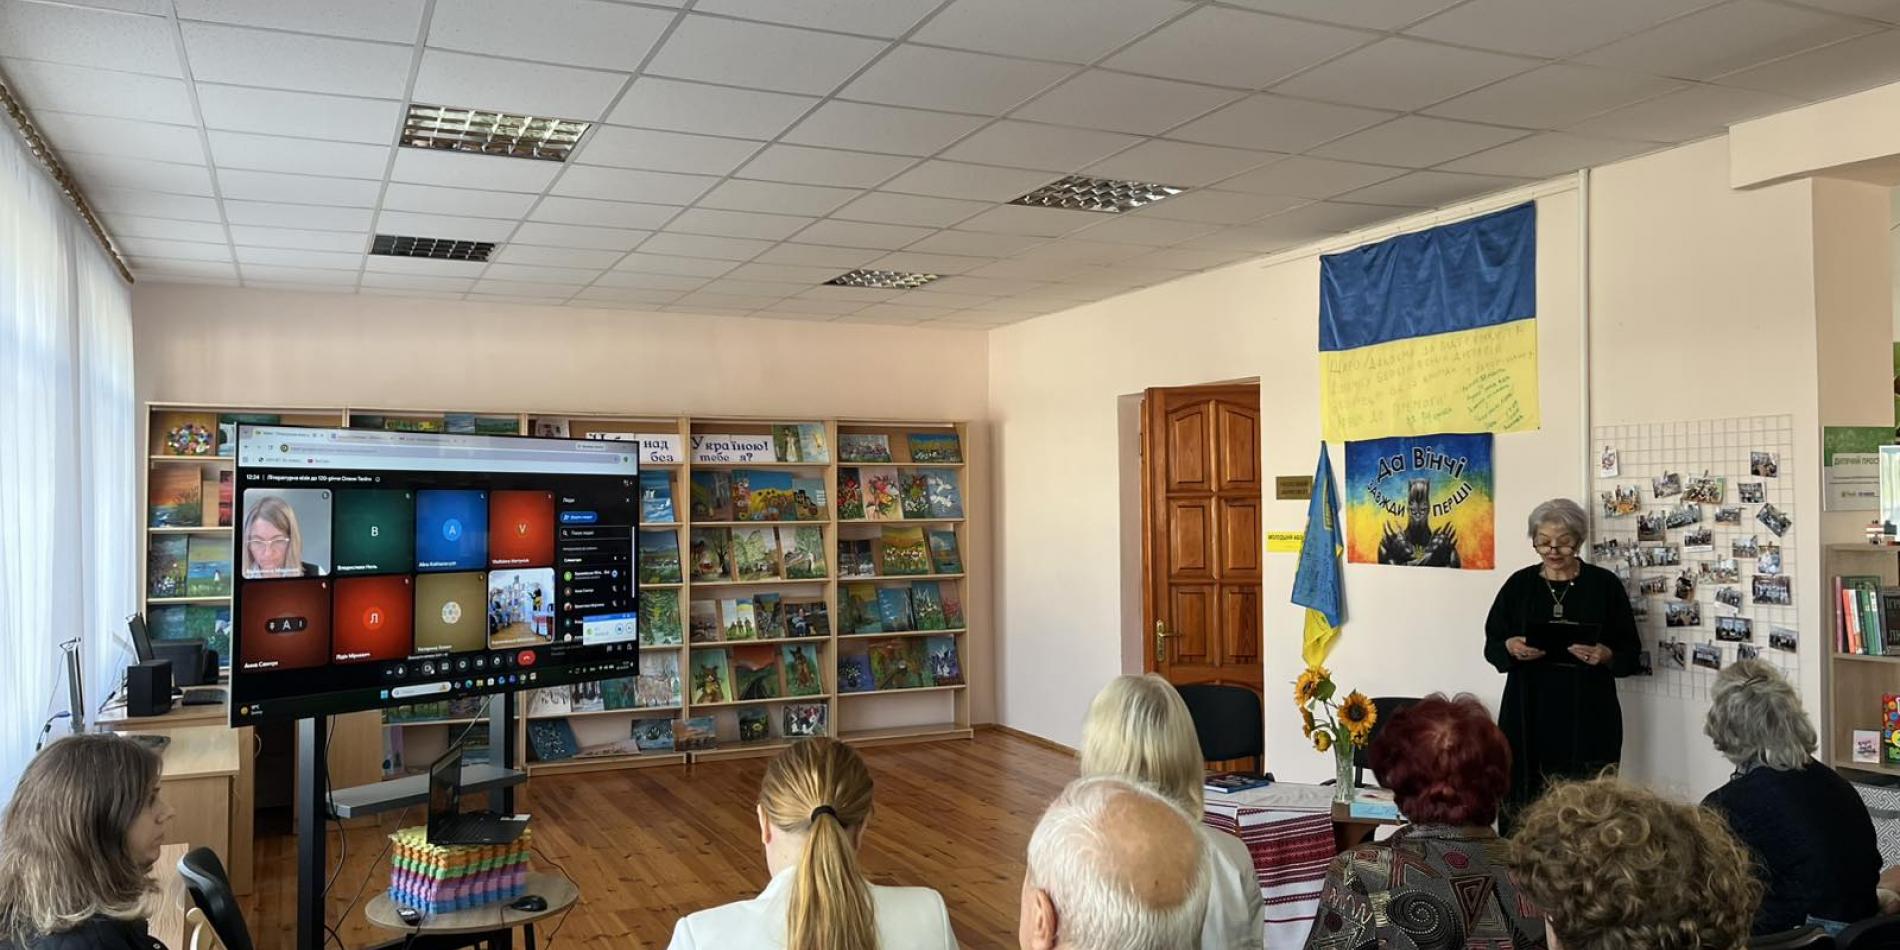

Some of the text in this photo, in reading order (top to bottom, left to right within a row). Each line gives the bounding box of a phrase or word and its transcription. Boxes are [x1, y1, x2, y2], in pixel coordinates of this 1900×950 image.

[644, 439, 670, 450] над
[651, 452, 675, 462] без
[700, 453, 730, 462] тебе
[1376, 446, 1468, 483] Да Вінчі
[1432, 480, 1473, 517] ПЕРШІ
[518, 524, 527, 534] V
